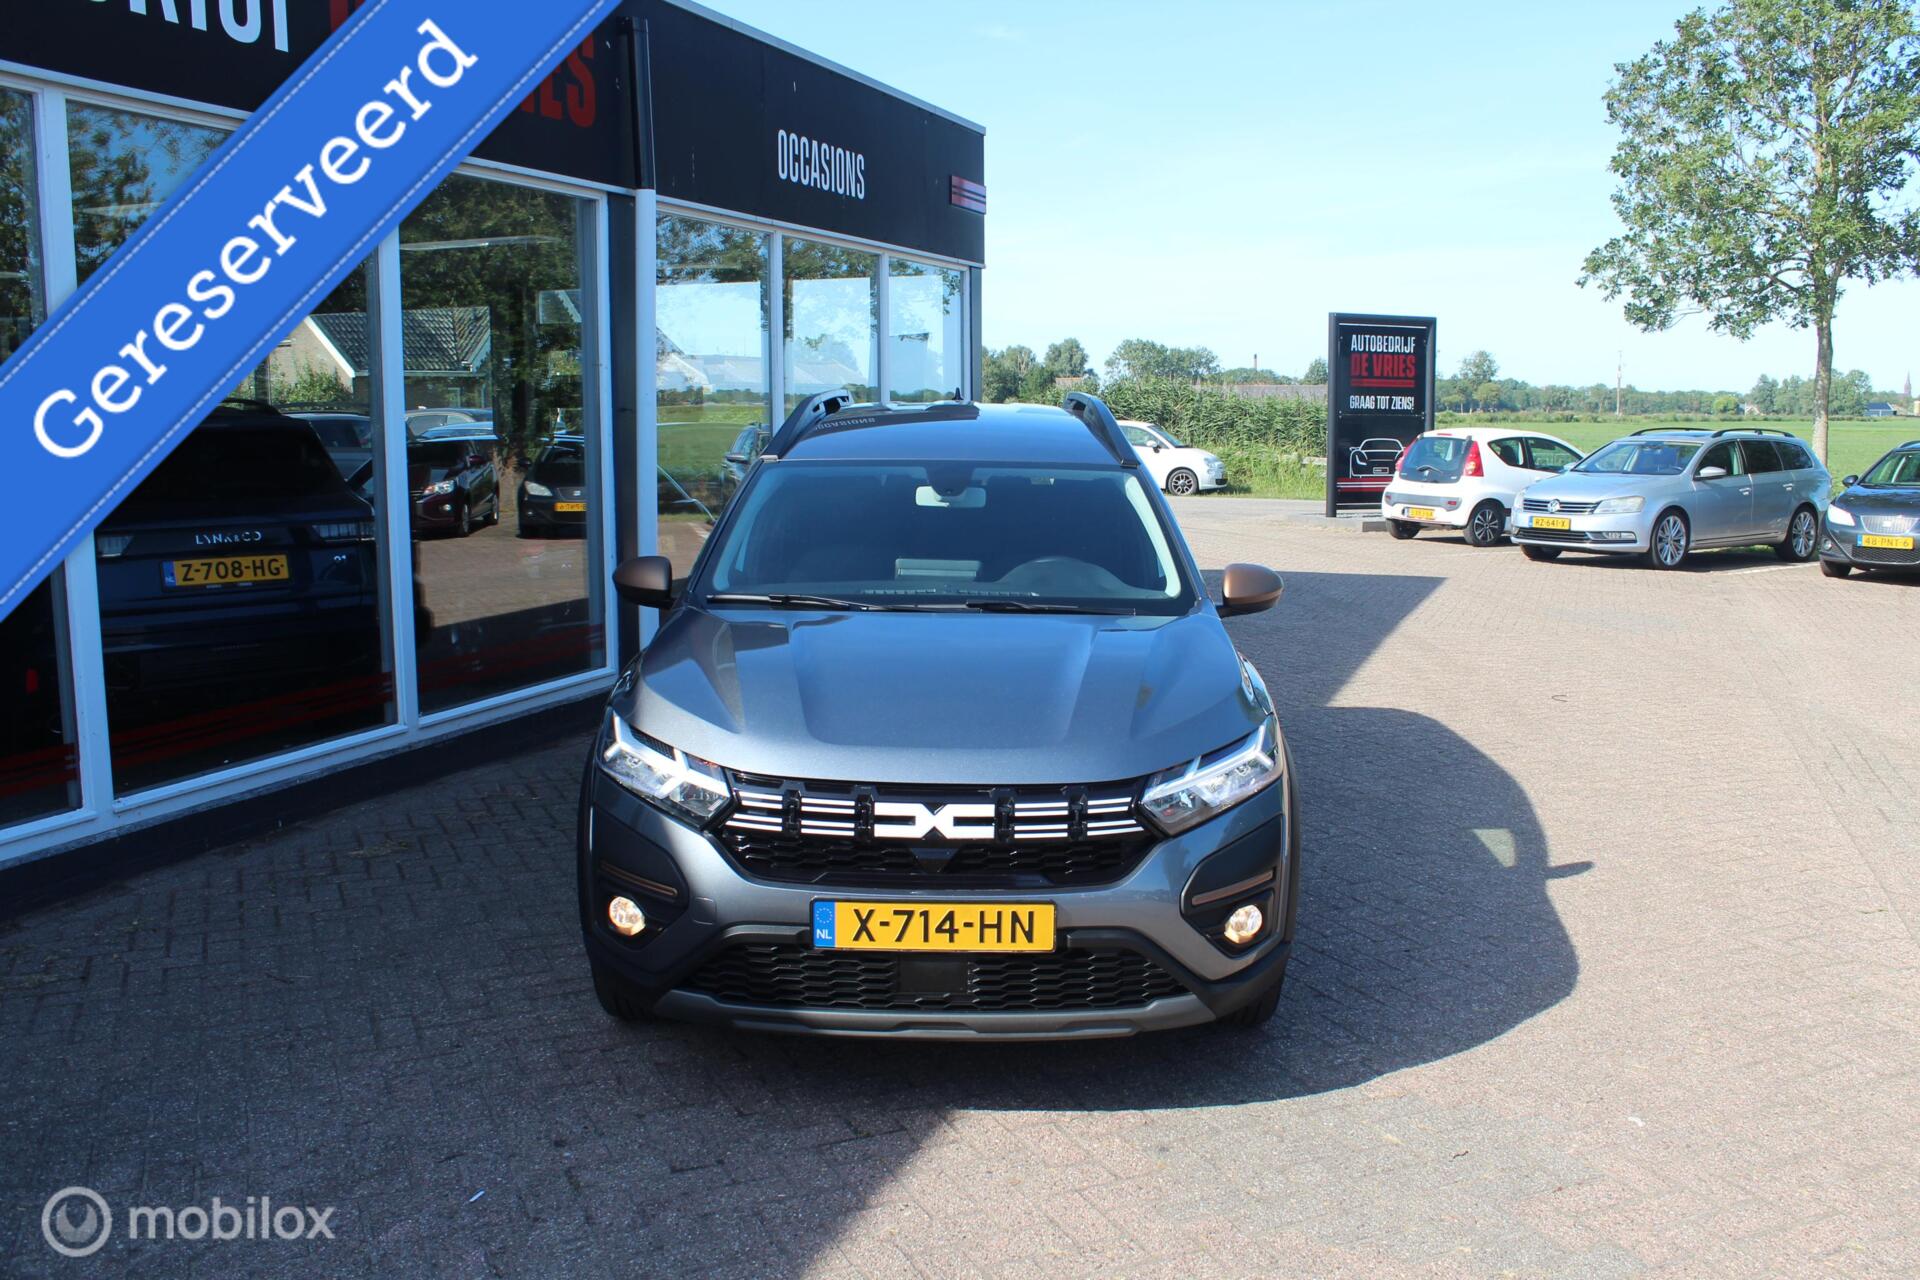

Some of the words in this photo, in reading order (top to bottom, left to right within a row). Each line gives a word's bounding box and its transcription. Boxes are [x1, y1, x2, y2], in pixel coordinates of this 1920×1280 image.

[778, 129, 865, 200] OCCASIONS
[1351, 334, 1415, 353] AUTOBEDRIJF
[1351, 353, 1368, 376] DE
[1373, 353, 1415, 377] VRIES
[1349, 395, 1376, 410] GRAAG
[1377, 396, 1390, 410] TOT
[1391, 396, 1414, 410] ZIENS!
[181, 558, 281, 582] Z-708-HG
[816, 929, 832, 940] NL
[852, 908, 1035, 944] X-714-HN
